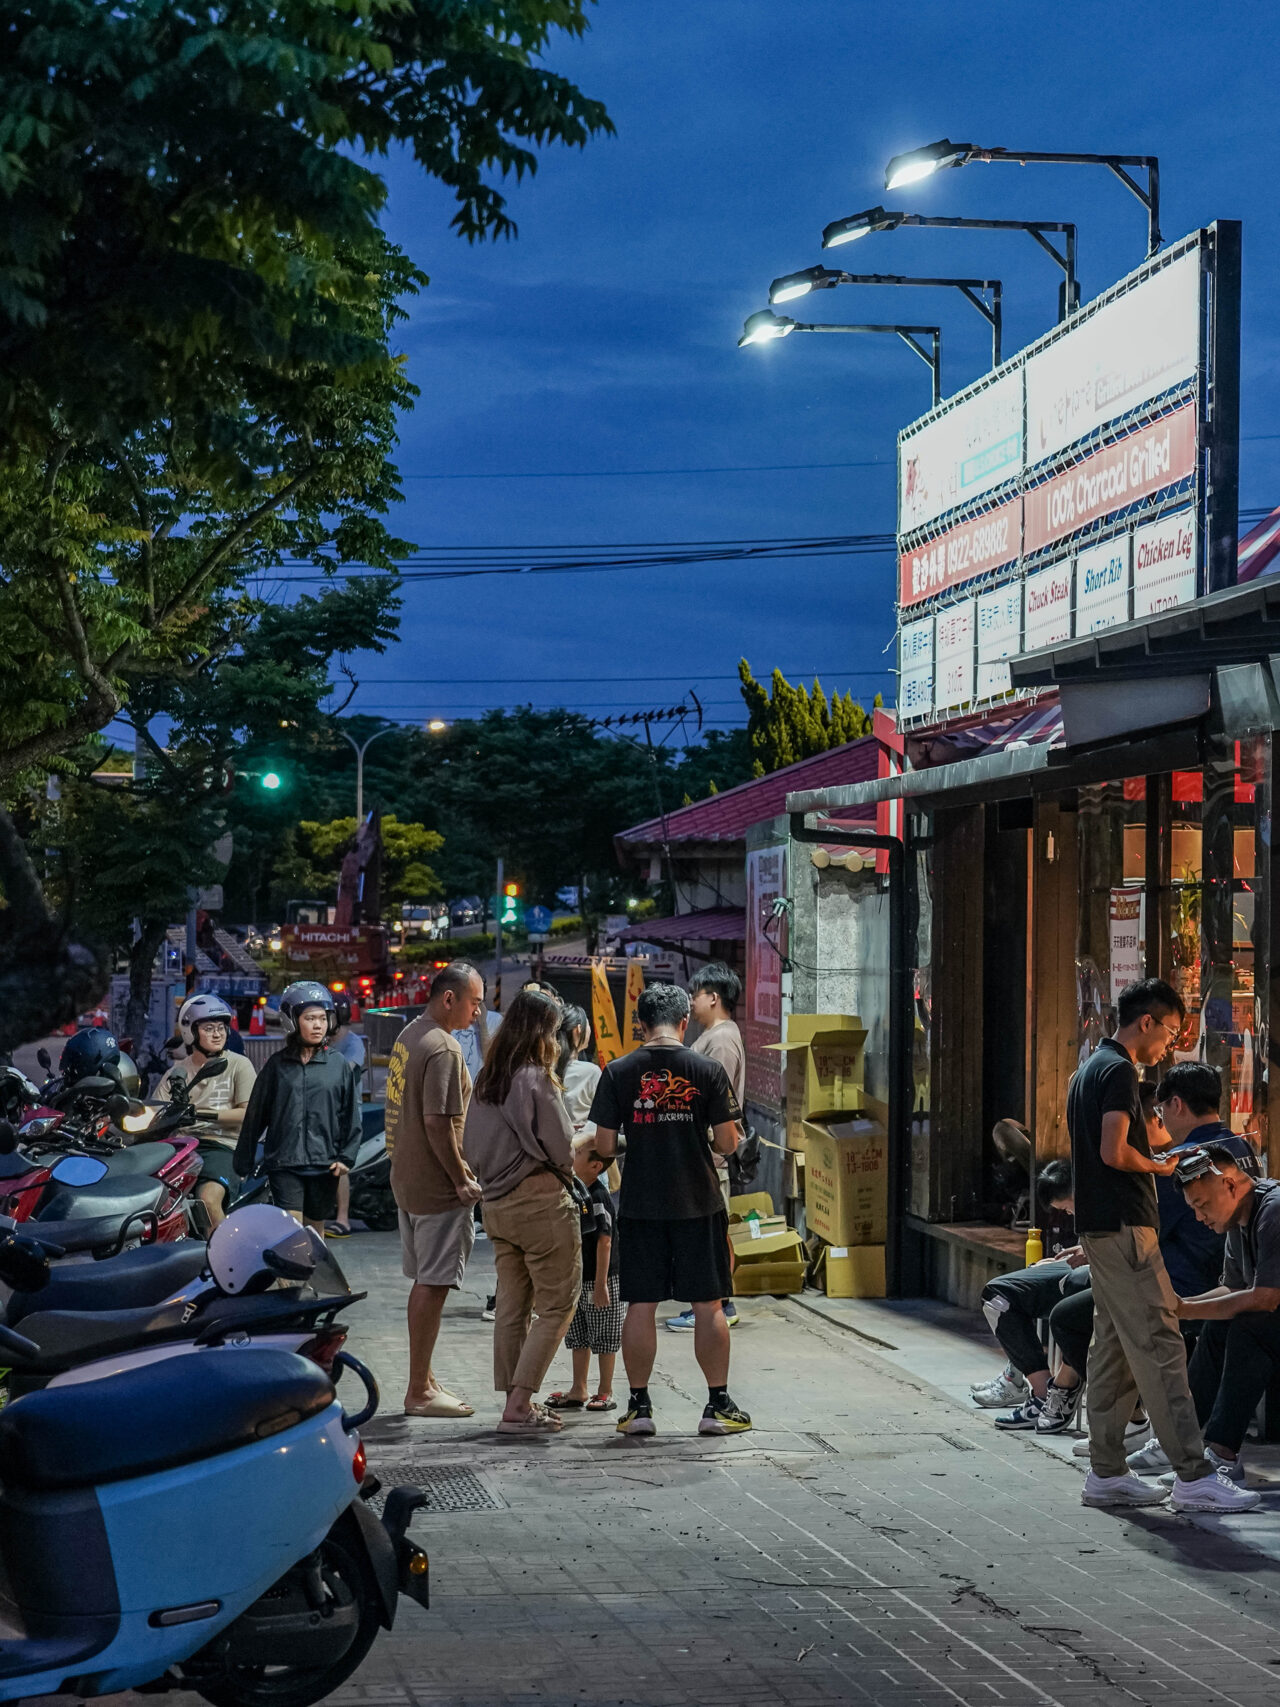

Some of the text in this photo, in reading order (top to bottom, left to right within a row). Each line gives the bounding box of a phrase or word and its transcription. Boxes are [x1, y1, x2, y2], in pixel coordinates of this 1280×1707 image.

[1047, 478, 1075, 532] 100%
[1076, 451, 1128, 515] Charcoal
[1129, 428, 1171, 489] Grilled
[1137, 529, 1194, 570] Chicken Leg
[1084, 556, 1123, 594] Short Rib
[1028, 576, 1070, 613] Chuck Steak
[301, 932, 350, 942] HITACHI
